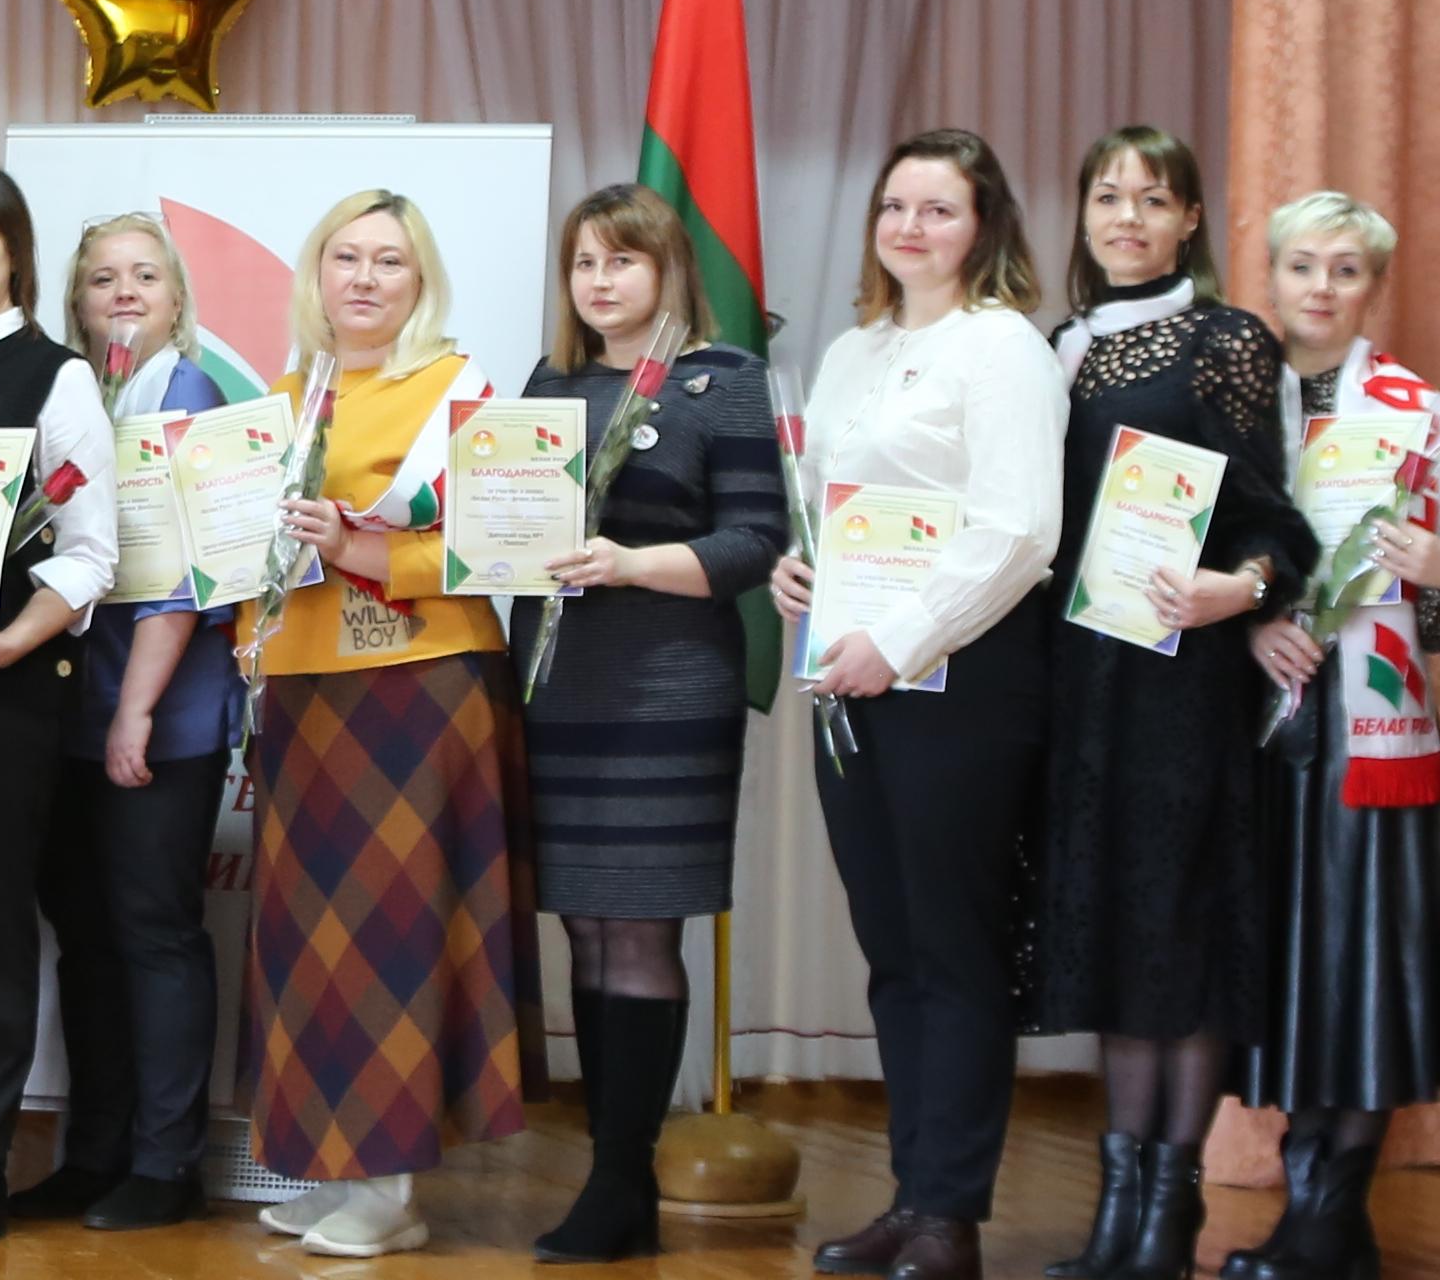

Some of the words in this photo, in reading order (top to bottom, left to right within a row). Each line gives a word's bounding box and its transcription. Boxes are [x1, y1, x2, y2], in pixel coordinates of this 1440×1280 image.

[116, 477, 164, 490] АРНОСТЬ
[194, 464, 279, 493] БЛАГОДАРНОСТЬ
[471, 467, 561, 479] БЛАГОДАРНОСТЬ
[1116, 501, 1186, 529] БЛАГОДАРНОСТЬ
[353, 625, 395, 650] BOY
